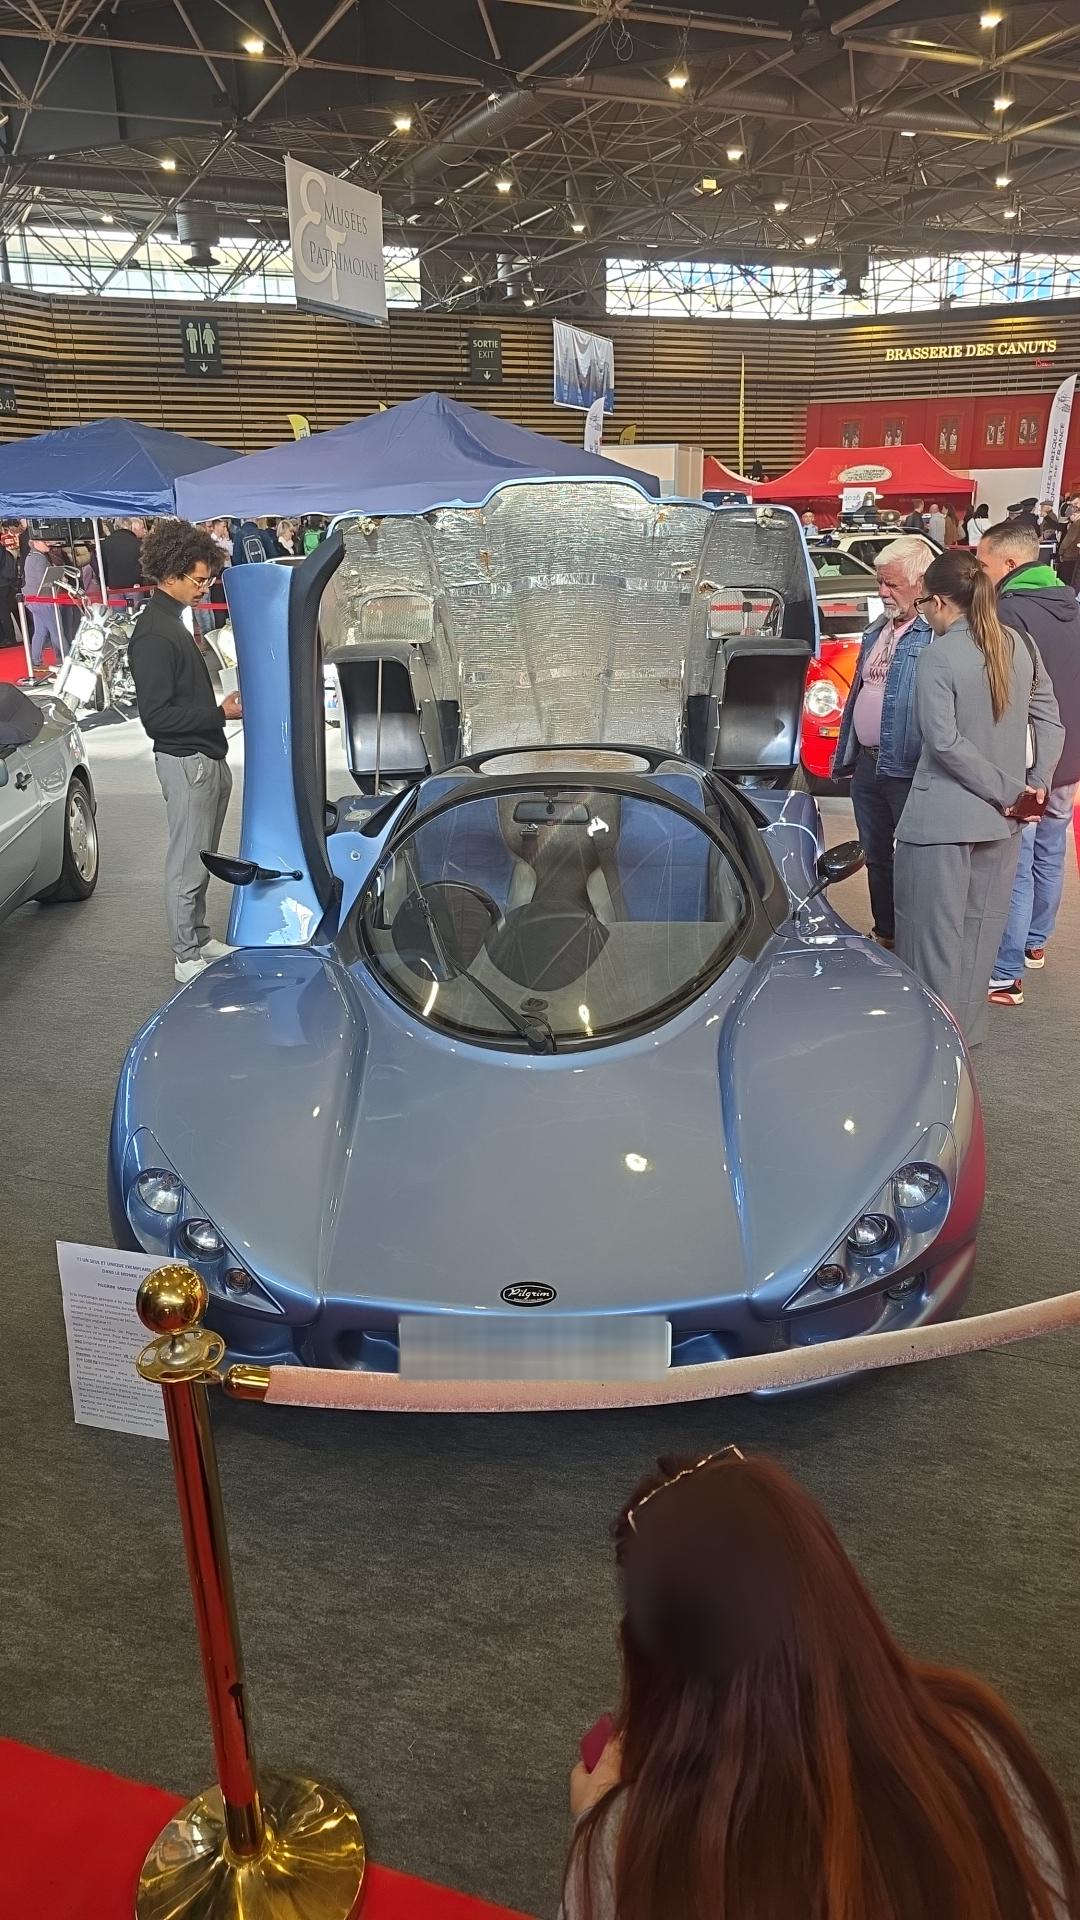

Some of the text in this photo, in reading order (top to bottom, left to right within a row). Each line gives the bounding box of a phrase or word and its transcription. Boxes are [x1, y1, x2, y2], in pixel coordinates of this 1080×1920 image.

[324, 200, 368, 235] MUSÉES
[309, 240, 379, 281] PATRIMOINE
[472, 339, 499, 348] SORTIE
[478, 350, 494, 358] EXIT
[885, 340, 1057, 361] BRASSERIE DES CANUTS
[1055, 423, 1065, 461] FRANCE
[1046, 428, 1058, 494] HISTORIQUE
[507, 1288, 550, 1300] Pilgrim
